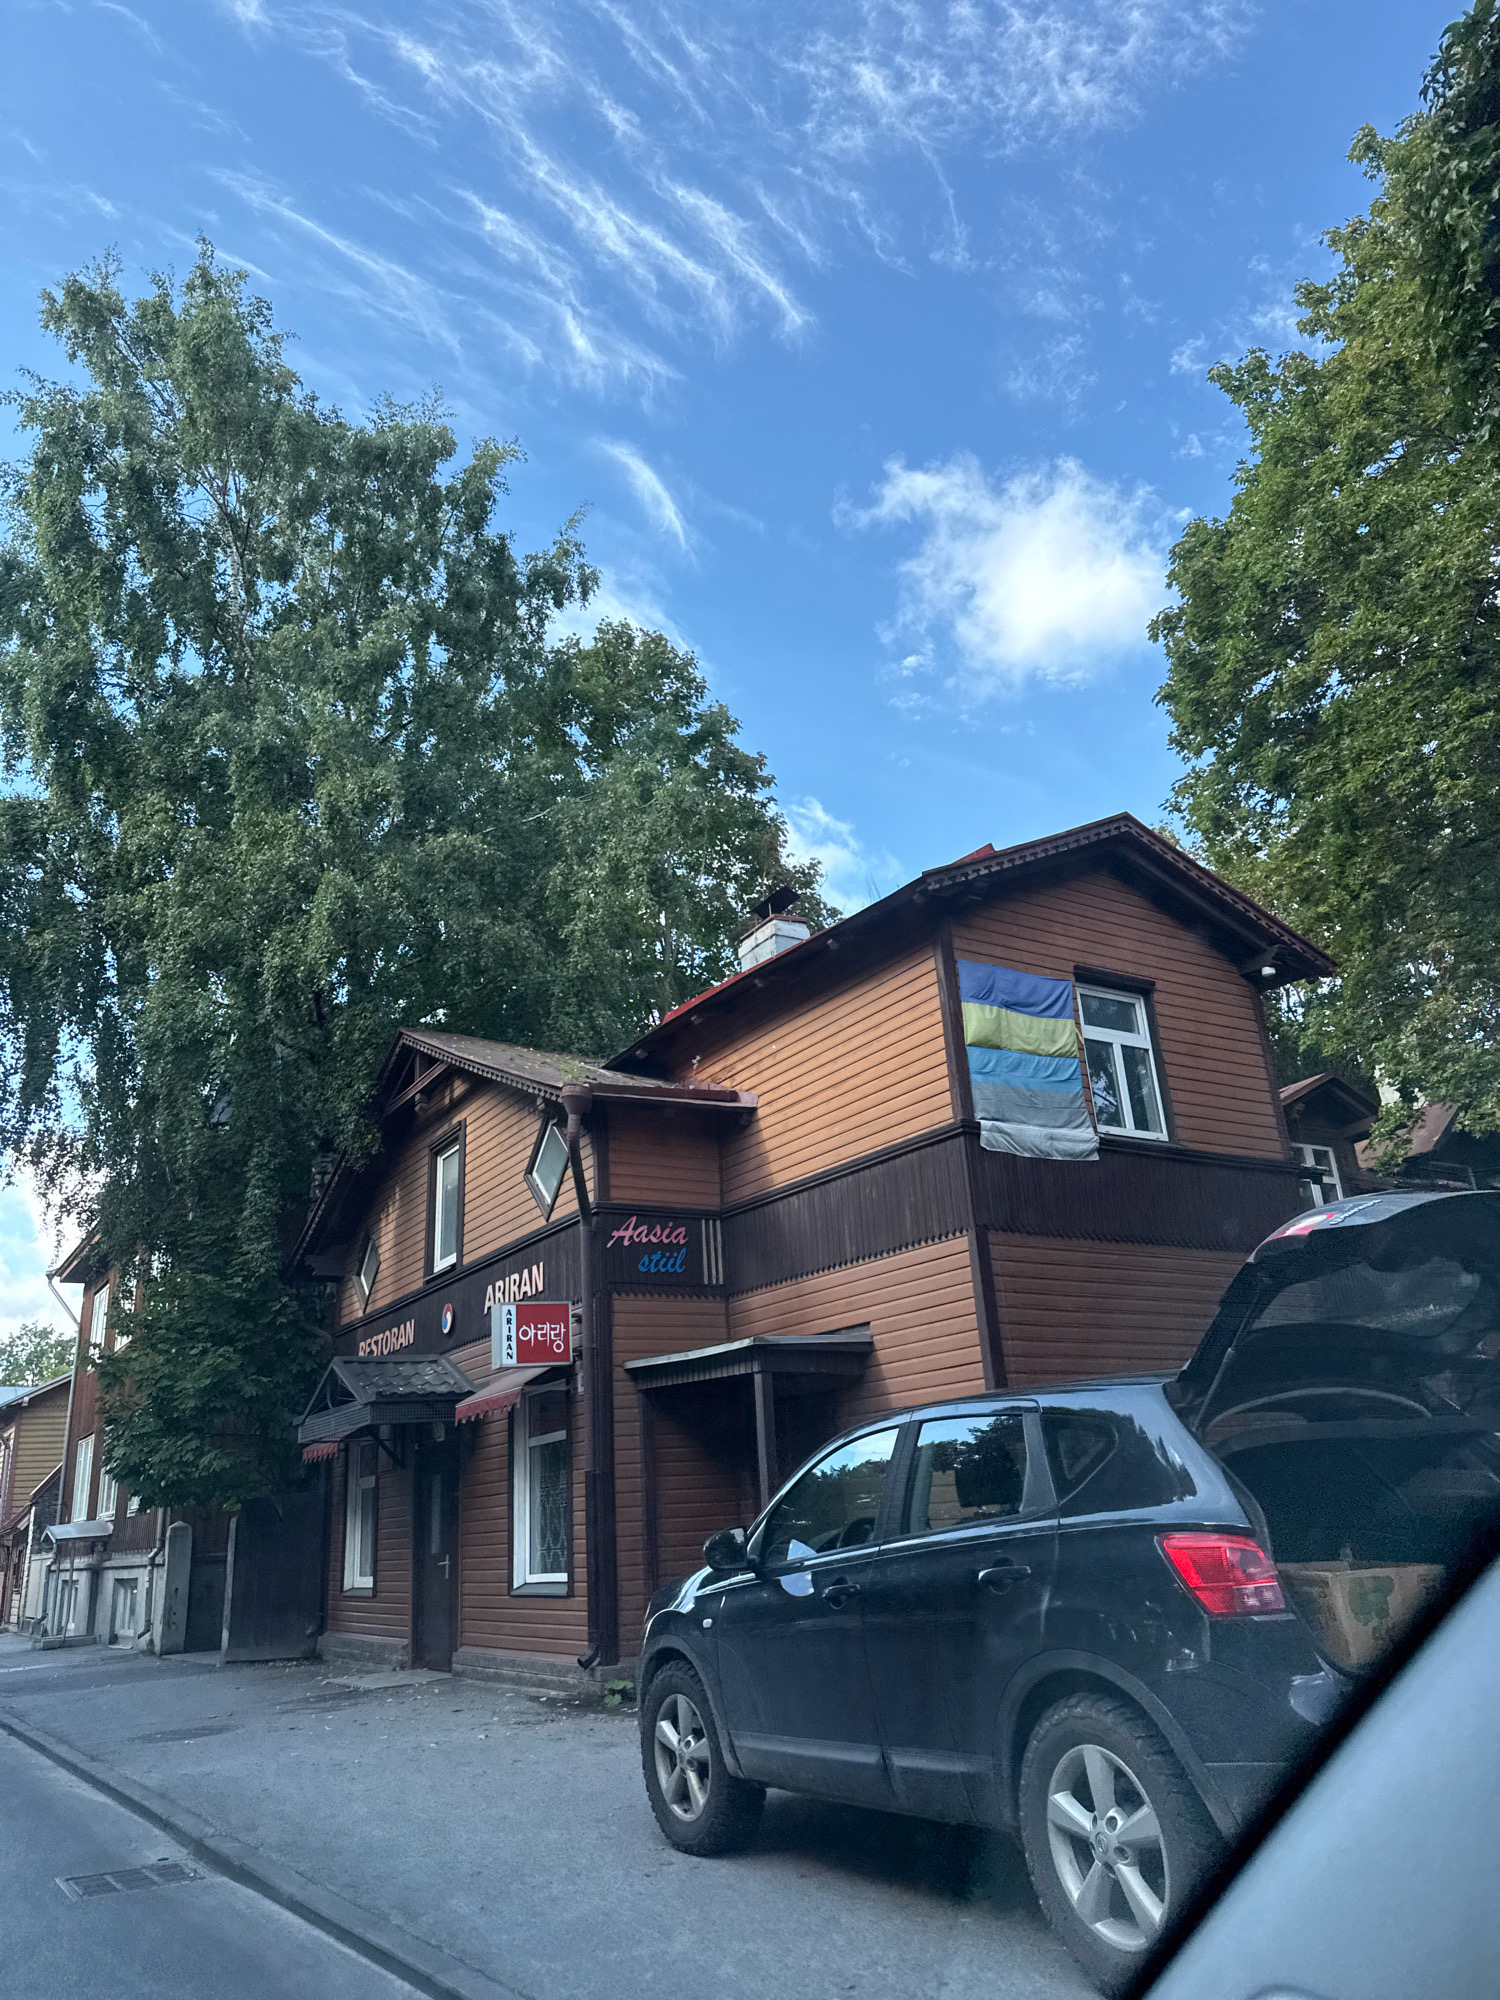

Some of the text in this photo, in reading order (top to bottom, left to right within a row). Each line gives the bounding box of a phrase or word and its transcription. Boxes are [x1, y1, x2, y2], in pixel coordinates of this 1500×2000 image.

[607, 1215, 689, 1248] Aasia
[638, 1247, 687, 1273] stiil
[483, 1261, 544, 1315] ARIRAN
[358, 1318, 415, 1357] RESTORAN
[506, 1309, 514, 1360] ARIRAN
[518, 1321, 567, 1353] 아리랑
